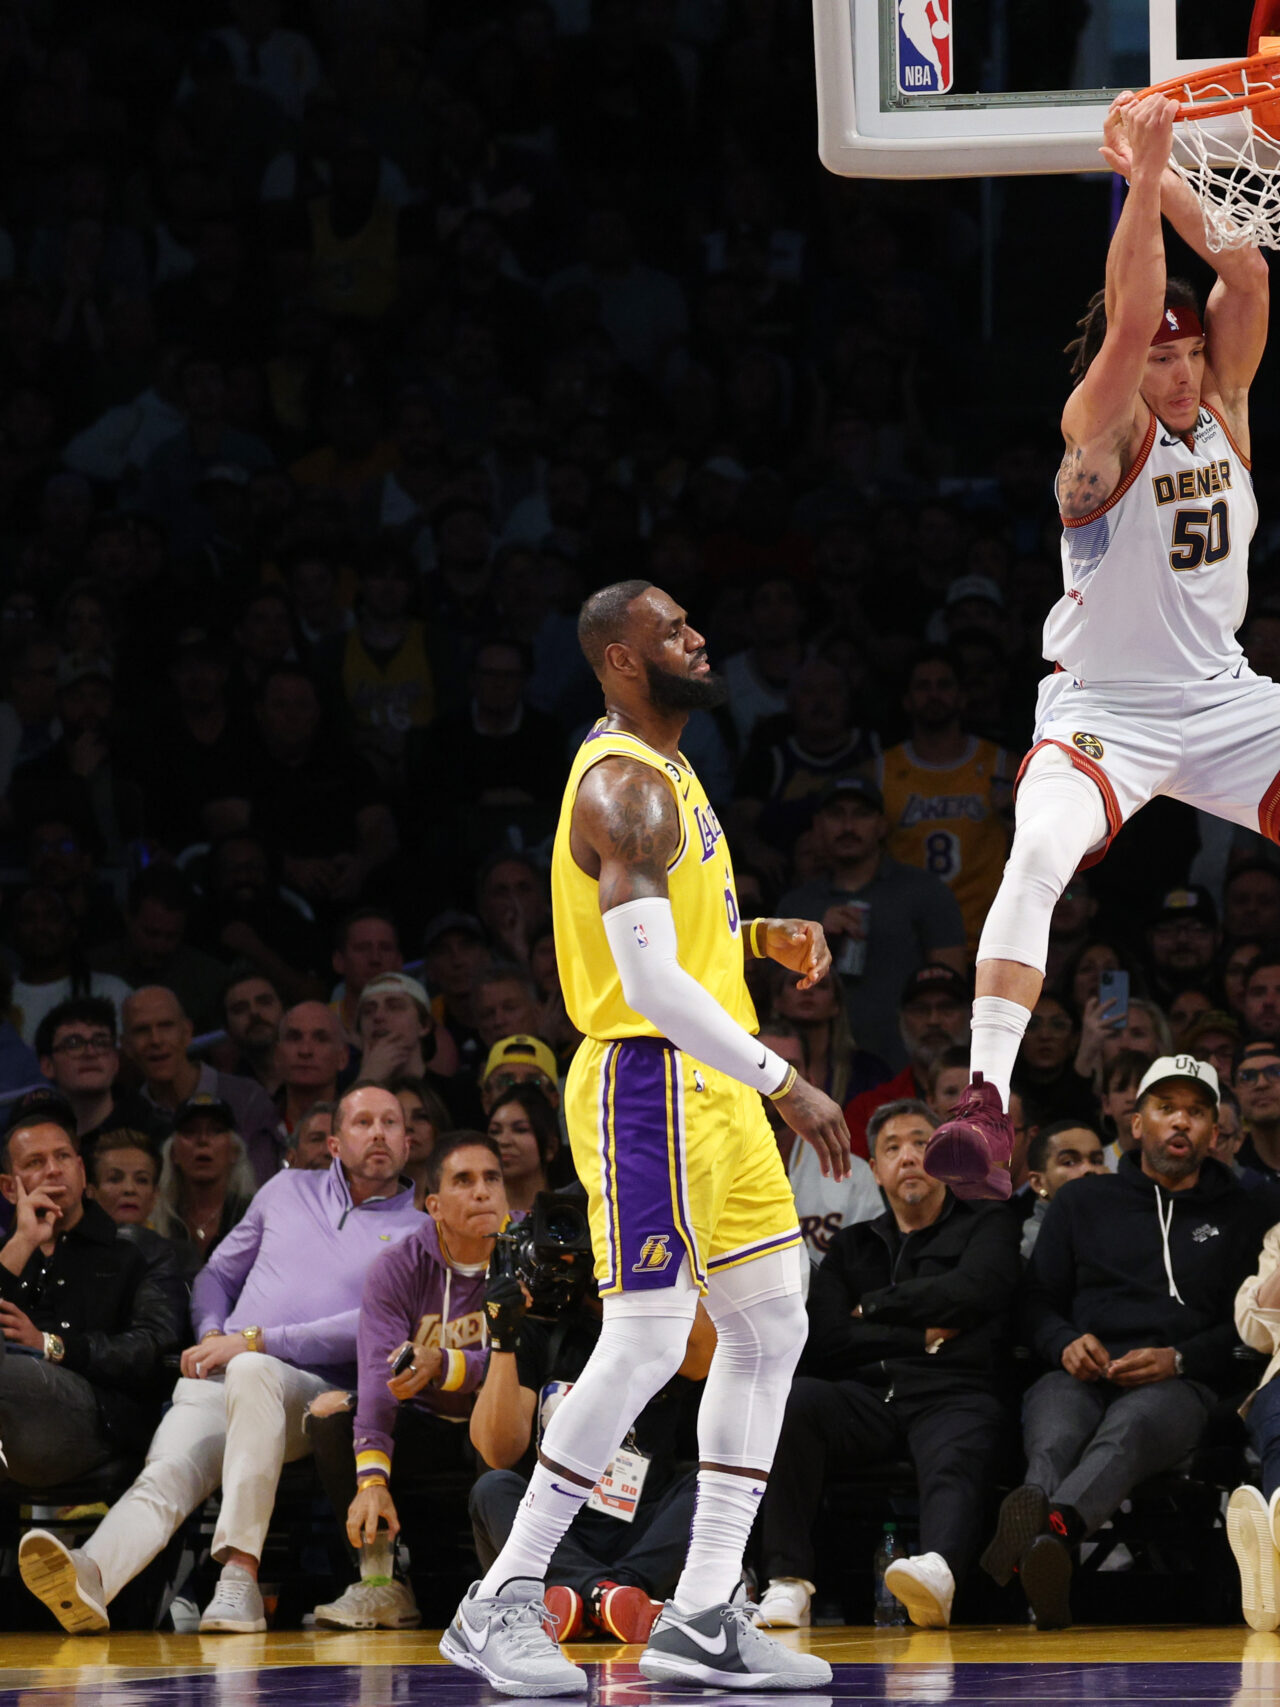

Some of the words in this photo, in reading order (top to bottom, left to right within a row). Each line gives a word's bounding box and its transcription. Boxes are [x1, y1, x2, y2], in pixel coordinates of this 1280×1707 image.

[904, 65, 932, 87] NBA
[1194, 423, 1218, 441] Western
[1201, 431, 1217, 444] Union
[1169, 499, 1231, 571] 50
[925, 830, 961, 881] 8
